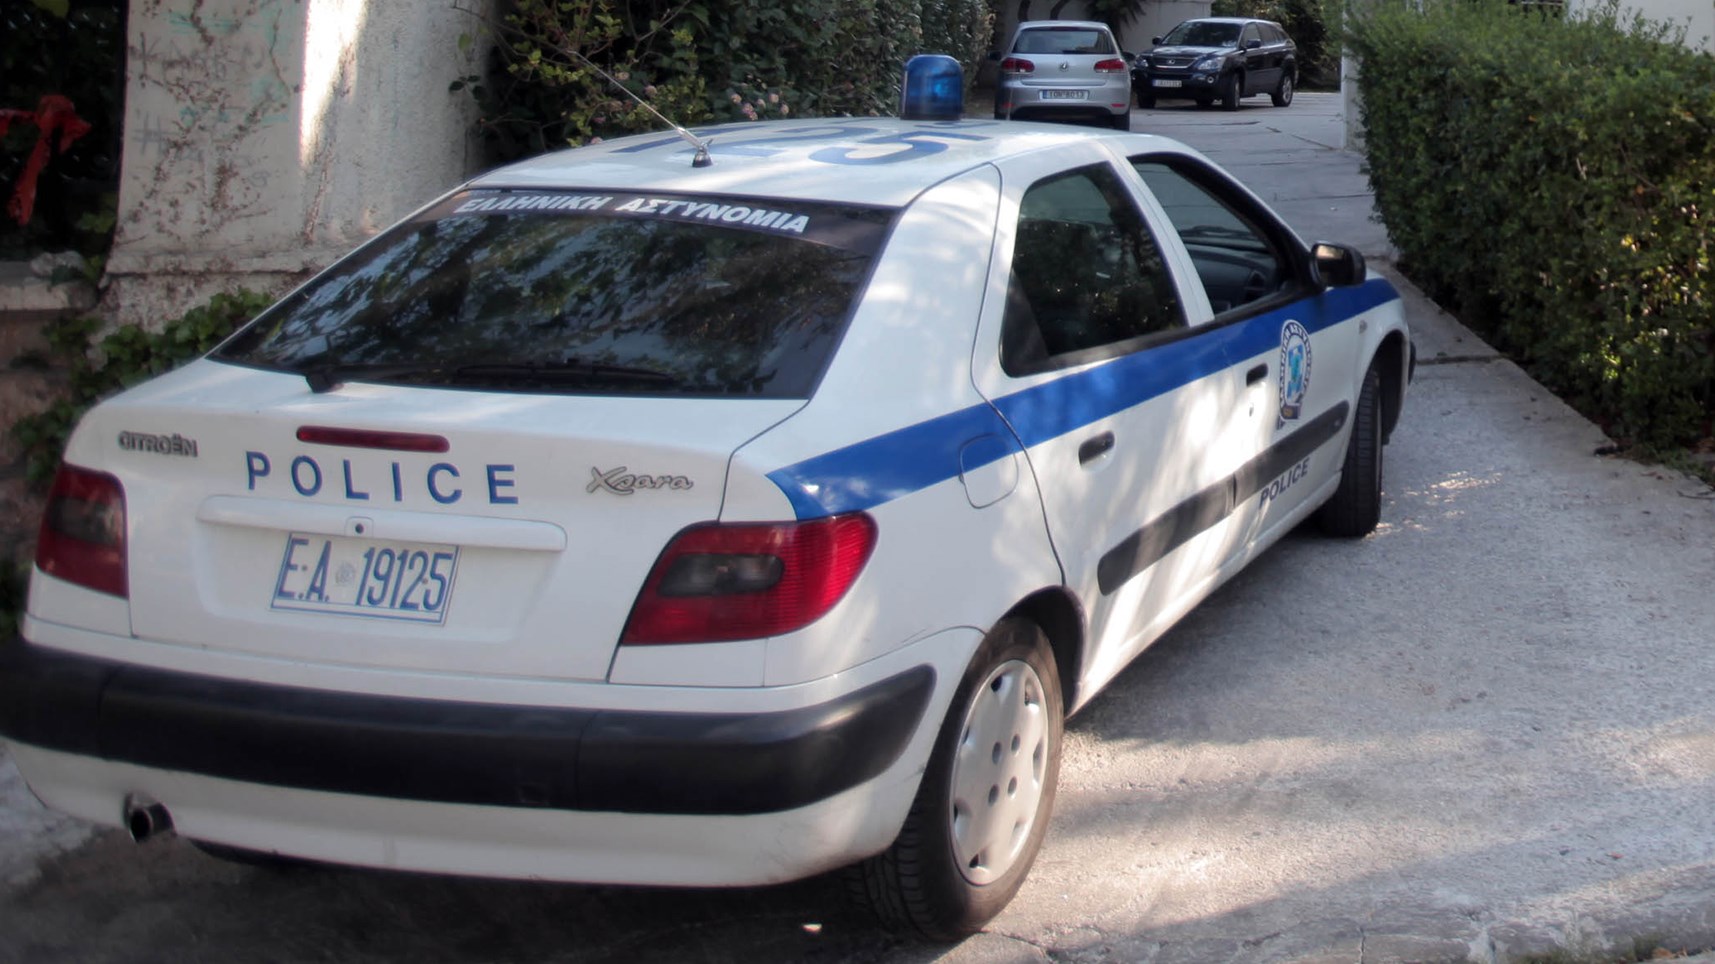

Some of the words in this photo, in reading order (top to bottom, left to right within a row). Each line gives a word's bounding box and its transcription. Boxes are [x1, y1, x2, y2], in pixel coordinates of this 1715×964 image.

[453, 196, 613, 213] ΕΛΛΗΝΙΚΗ
[615, 198, 810, 233] ΑΣΤΥΝΟΜΙΑ
[118, 430, 199, 458] CITROËN
[245, 450, 519, 504] POLICE
[586, 466, 694, 496] Xsara
[1259, 457, 1310, 509] POLICE
[355, 547, 454, 611] 19125
